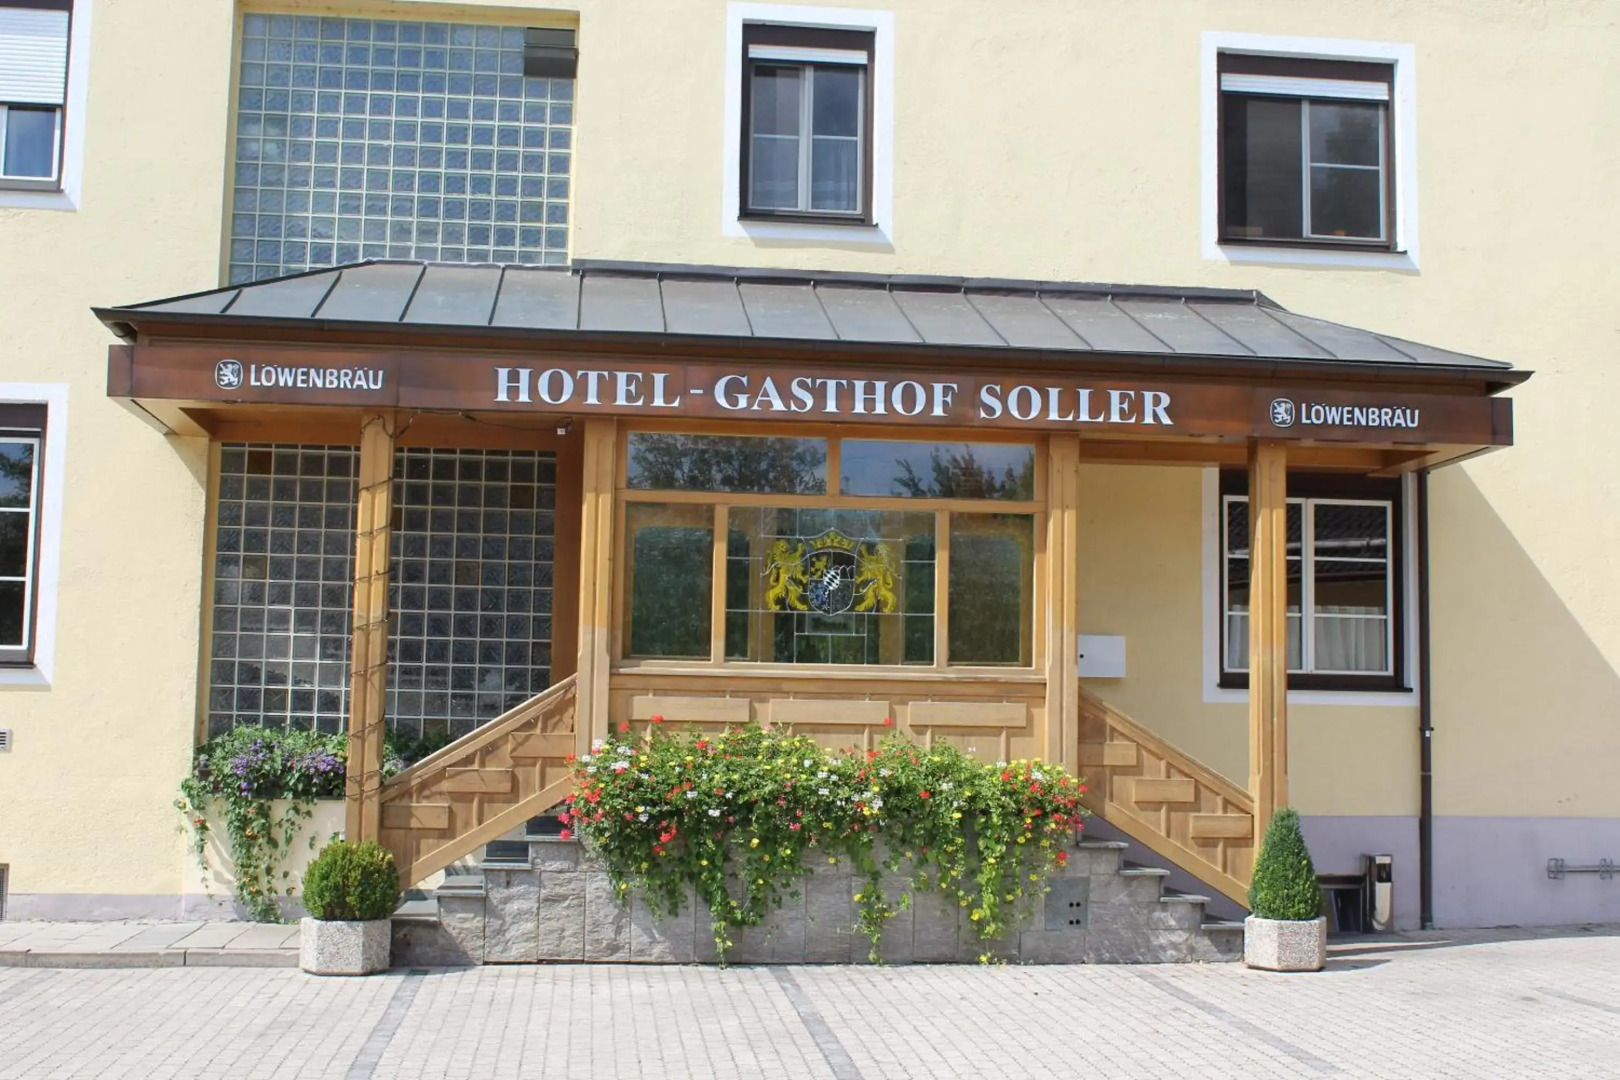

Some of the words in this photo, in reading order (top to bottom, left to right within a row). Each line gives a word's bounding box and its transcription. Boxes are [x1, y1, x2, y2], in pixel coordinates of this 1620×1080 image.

[249, 363, 385, 390] LÖWENBRÄU
[979, 383, 1174, 426] SOLLER
[1301, 402, 1420, 428] LÖWENBRÄU
